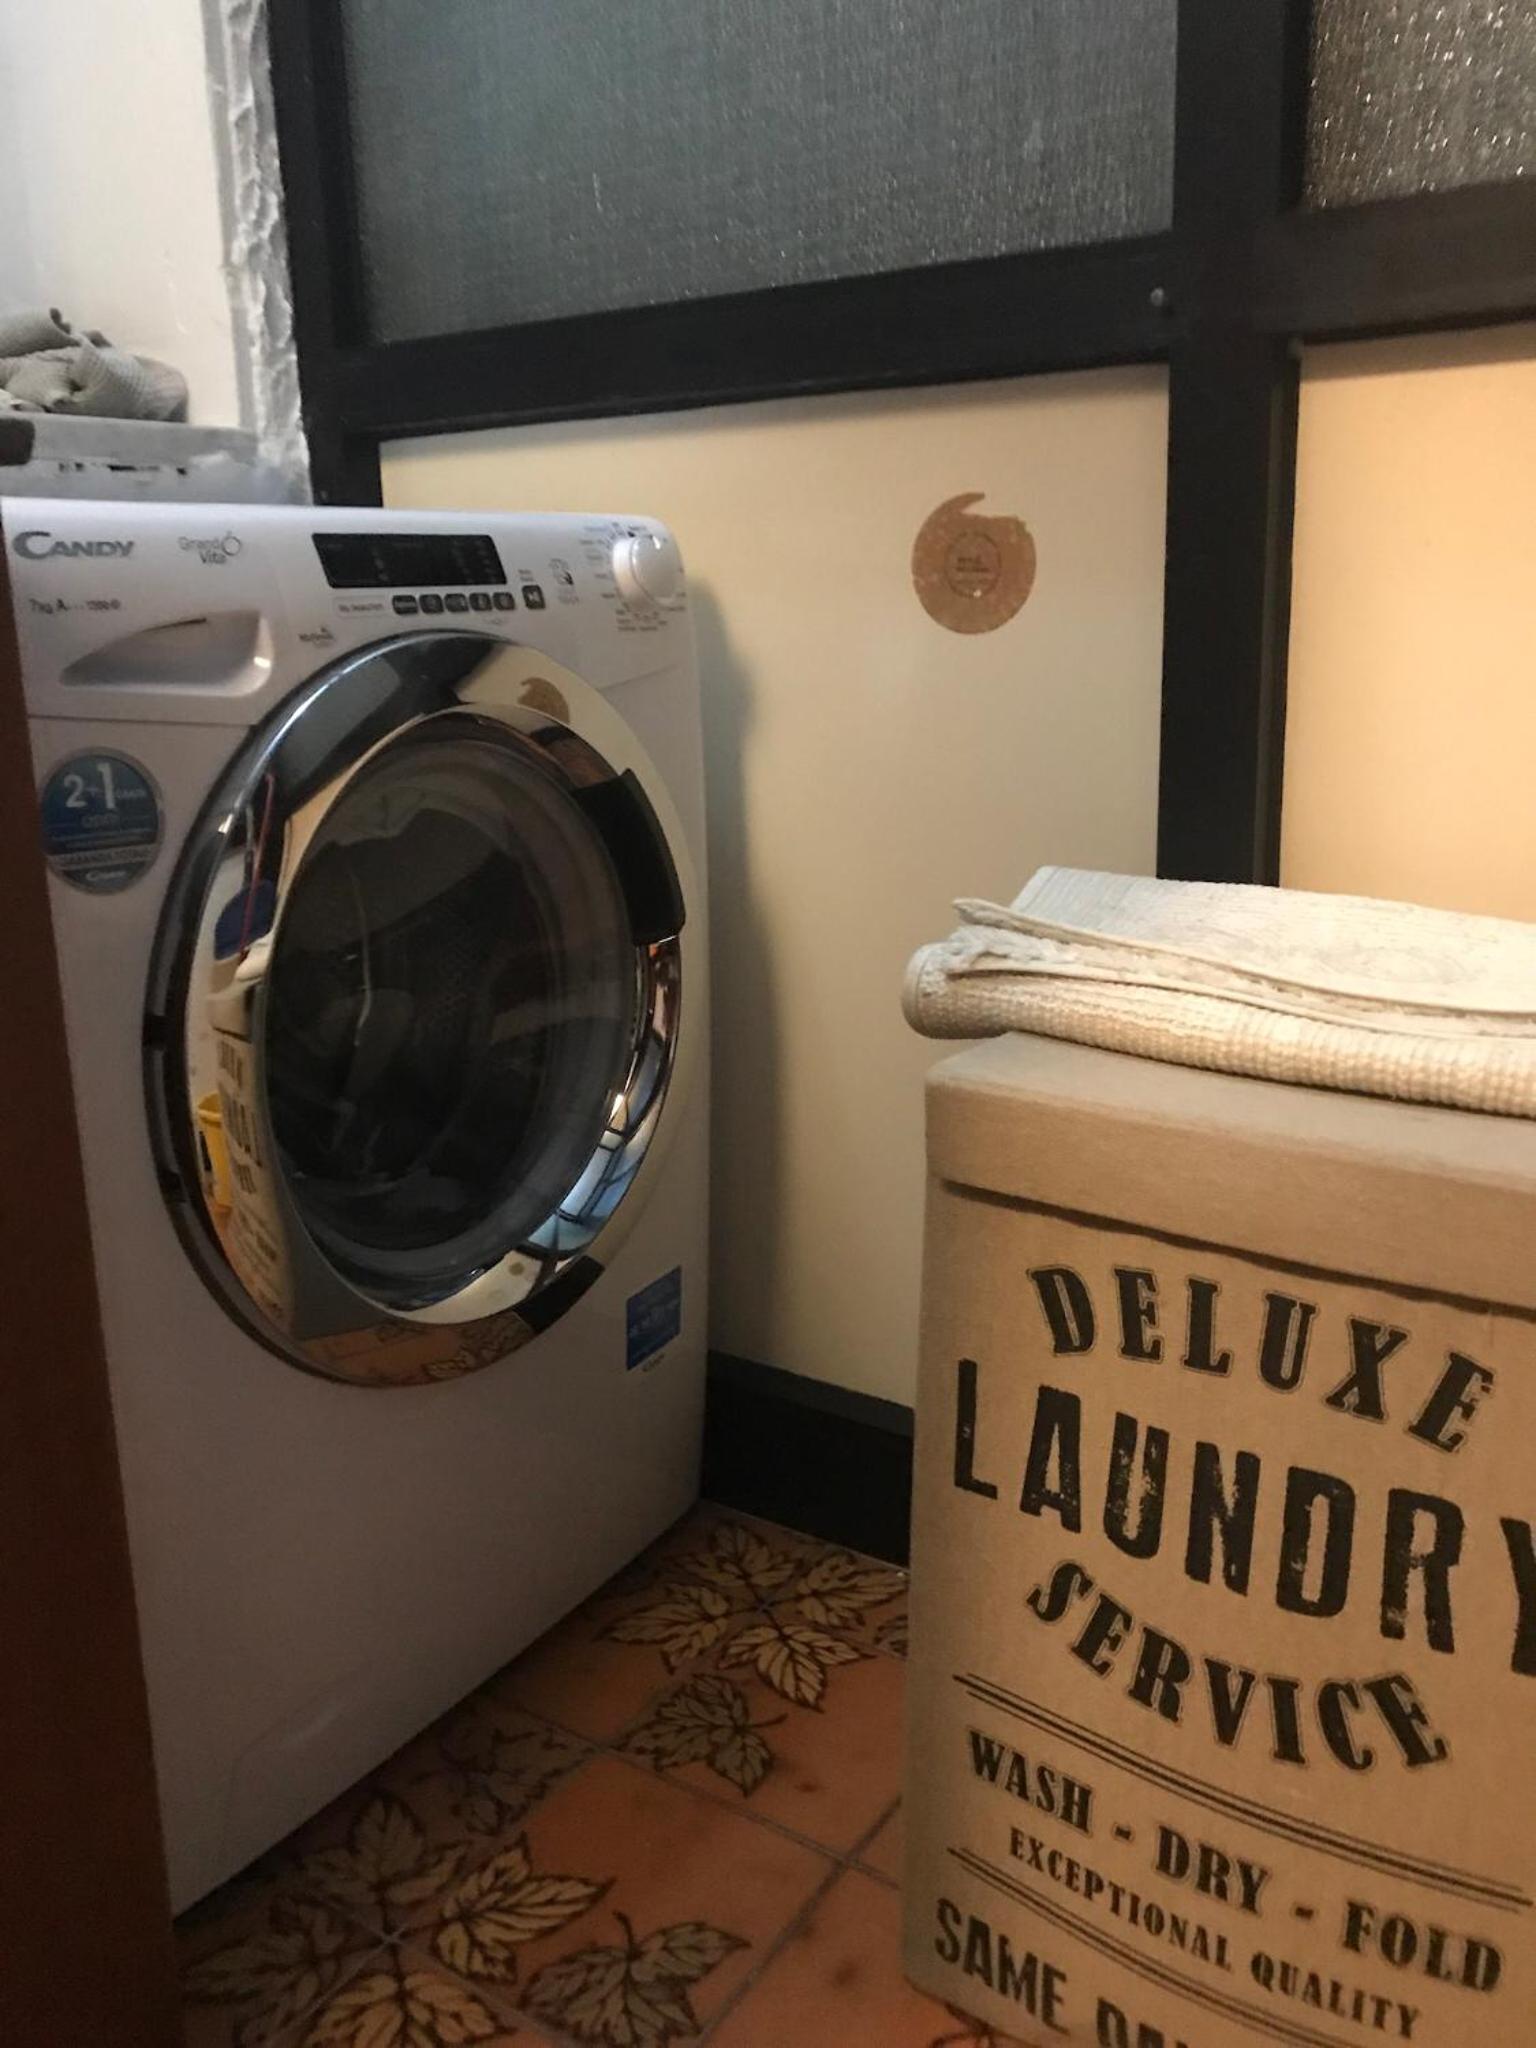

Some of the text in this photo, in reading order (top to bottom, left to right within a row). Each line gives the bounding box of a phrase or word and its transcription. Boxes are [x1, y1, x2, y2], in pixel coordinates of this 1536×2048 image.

[12, 531, 135, 560] CANDY
[1025, 1264, 1494, 1454] DELUXE
[1024, 1559, 1450, 1773] SERVICE
[966, 1728, 1094, 1835] WASH
[1153, 1824, 1273, 1918] DRY
[1340, 1900, 1505, 1994] FOLD
[1009, 1827, 1234, 1971] EXCEPTIONAL
[1250, 1952, 1425, 2040] QUALITY
[934, 1898, 1069, 2035] SAME
